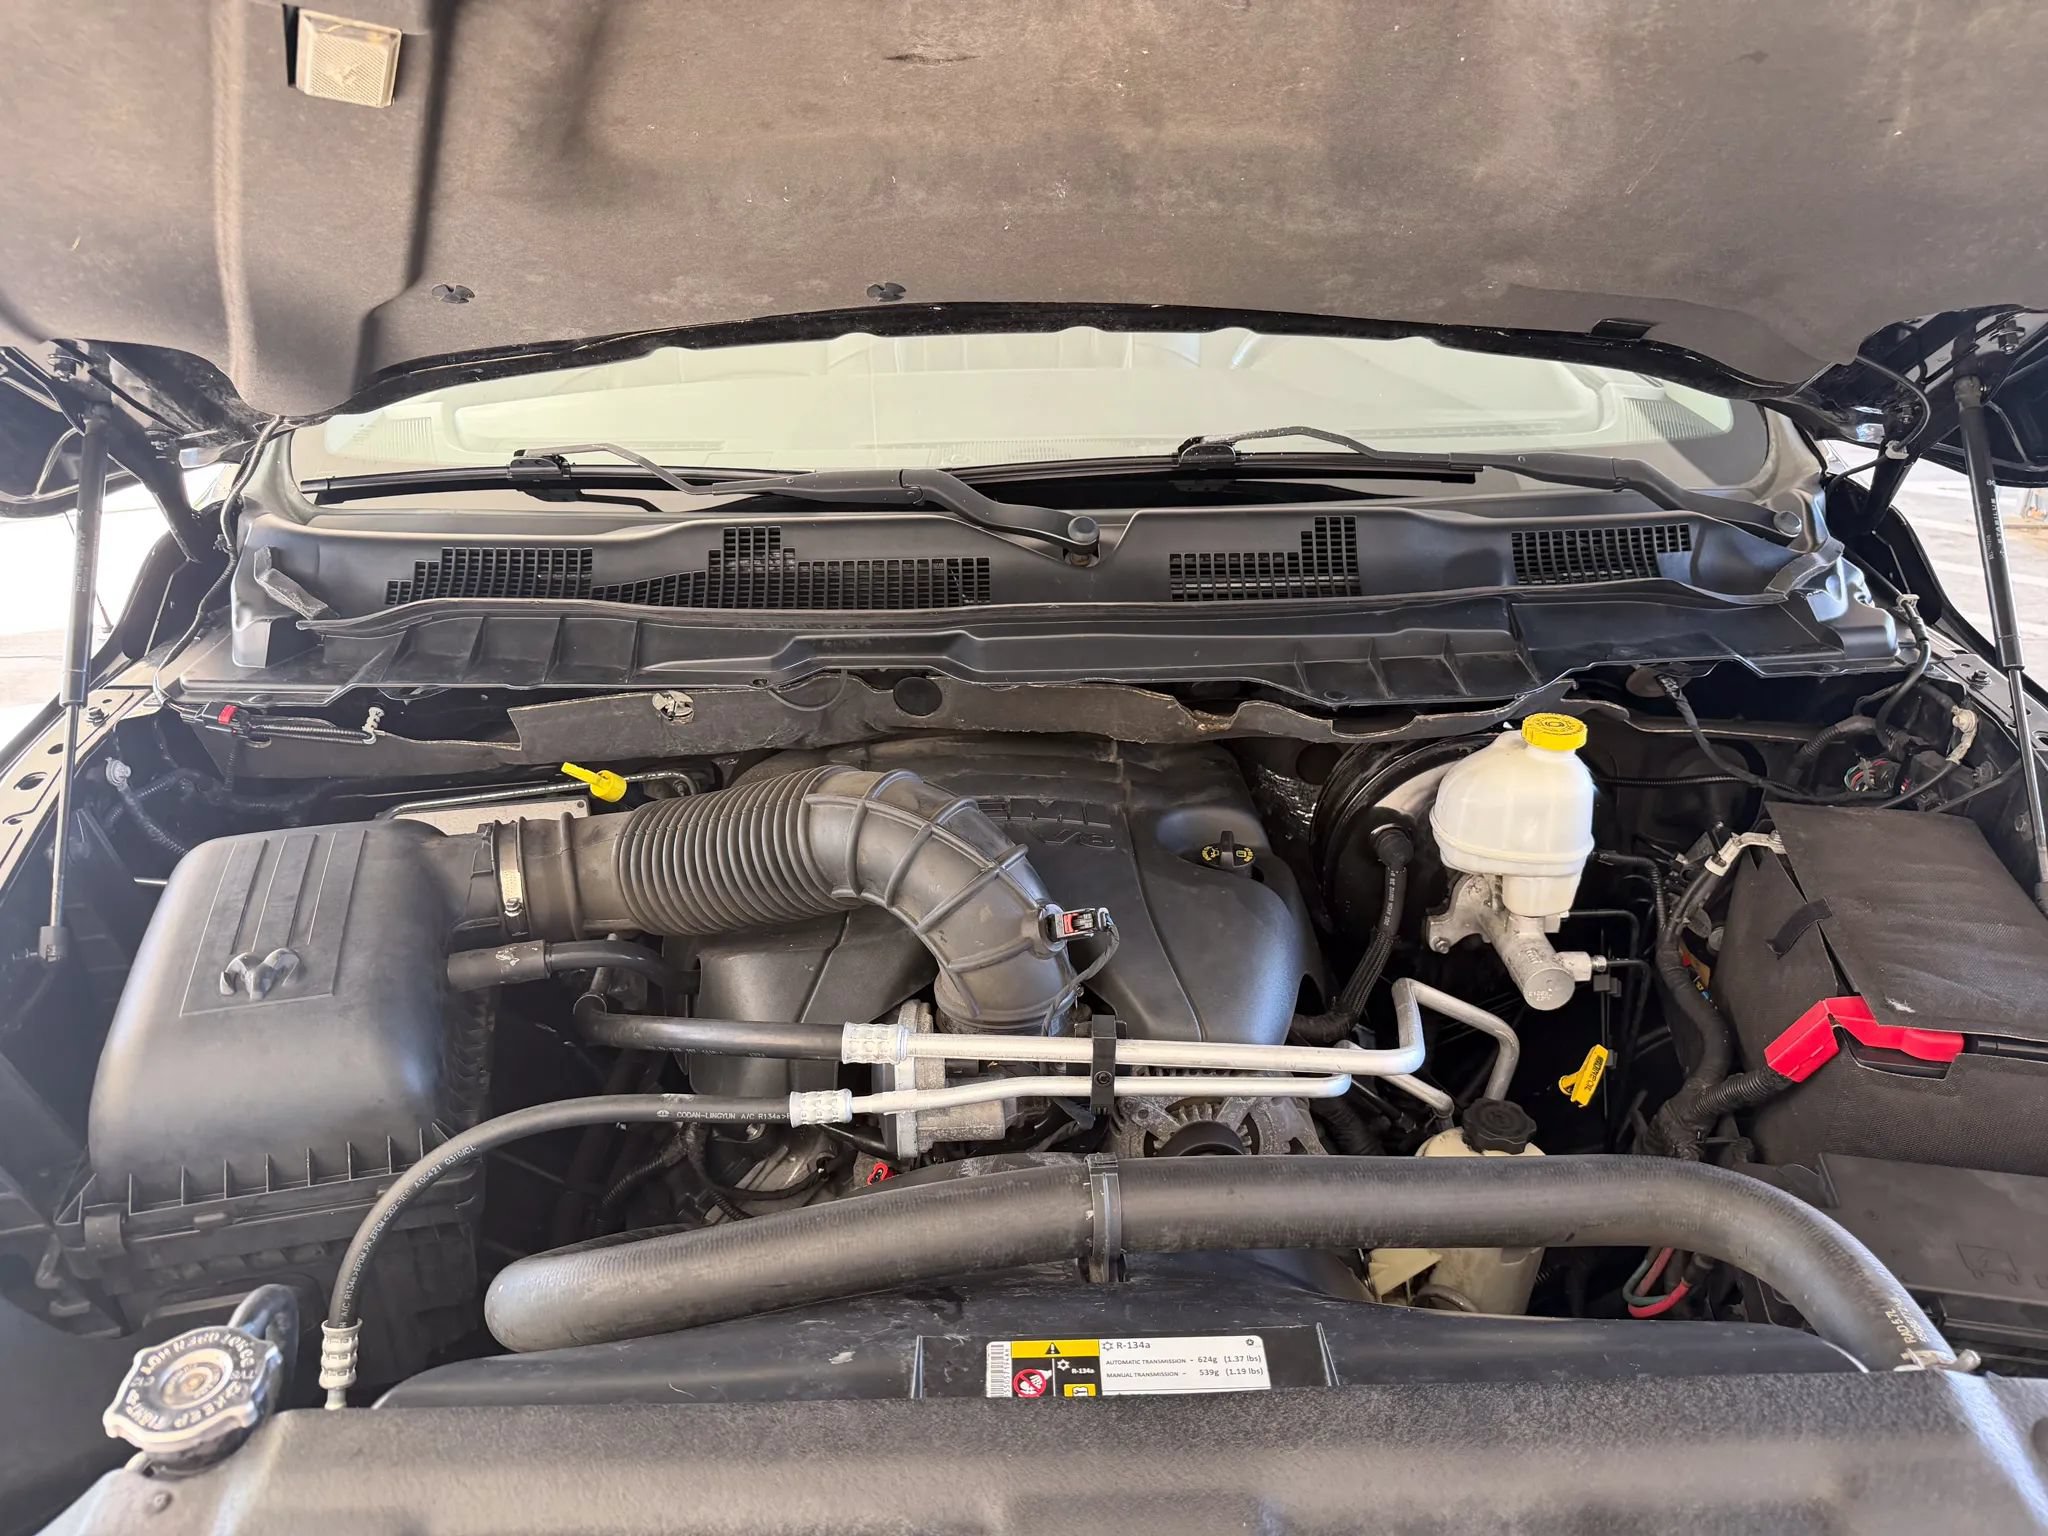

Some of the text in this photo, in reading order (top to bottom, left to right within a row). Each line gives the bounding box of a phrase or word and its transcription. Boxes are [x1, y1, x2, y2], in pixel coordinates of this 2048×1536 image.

[676, 1111, 736, 1120] CODAN-LINGYUN
[740, 1112, 755, 1120] A/C
[340, 1302, 352, 1318] A/C
[1116, 1341, 1151, 1350] R-134a
[1197, 1356, 1218, 1364] 624g
[1223, 1355, 1244, 1364] (1.37
[1246, 1354, 1262, 1363] lbs)
[1071, 1367, 1096, 1375] R-134a
[1199, 1369, 1220, 1377] 539g
[1225, 1368, 1247, 1377] (1.19
[1248, 1367, 1264, 1376] lbs)
